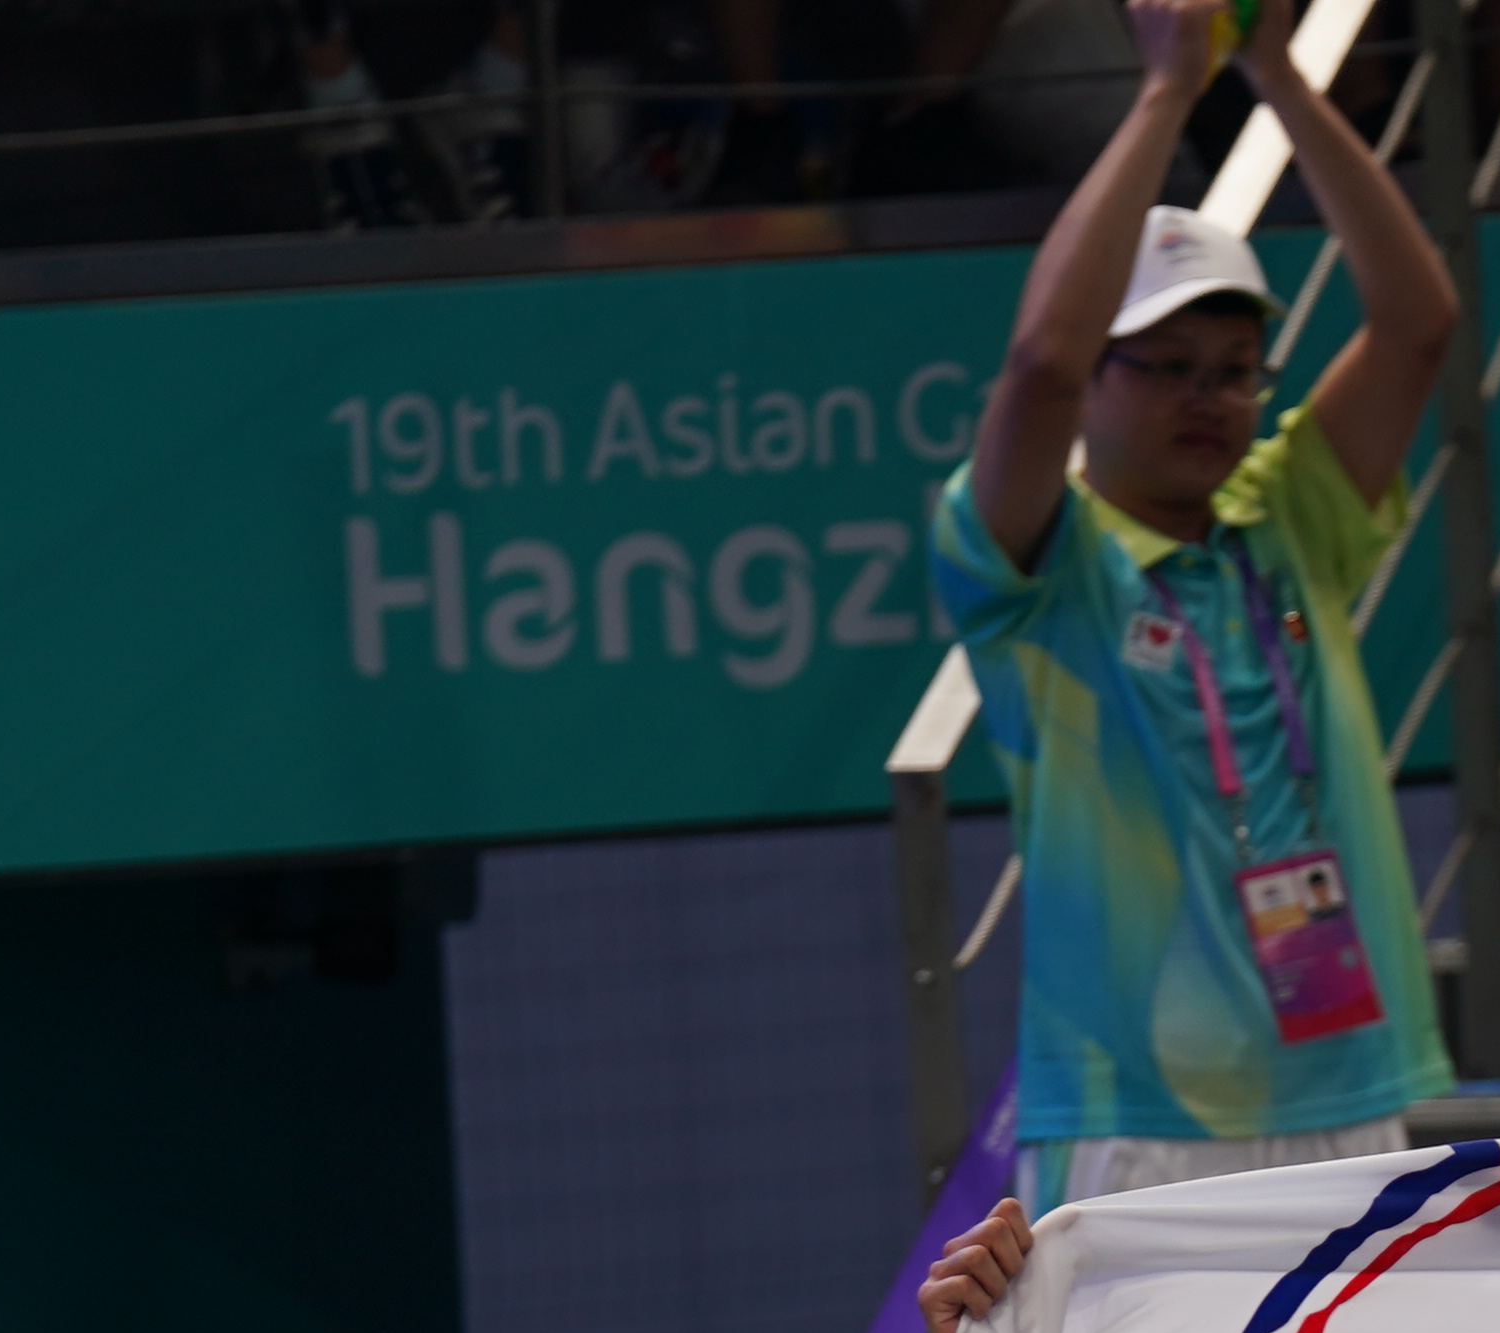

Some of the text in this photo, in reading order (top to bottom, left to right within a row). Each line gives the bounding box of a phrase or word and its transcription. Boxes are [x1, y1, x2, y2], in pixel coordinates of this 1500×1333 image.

[329, 391, 563, 496] 19th
[586, 374, 878, 484] Asian
[343, 482, 955, 688] Hangz
